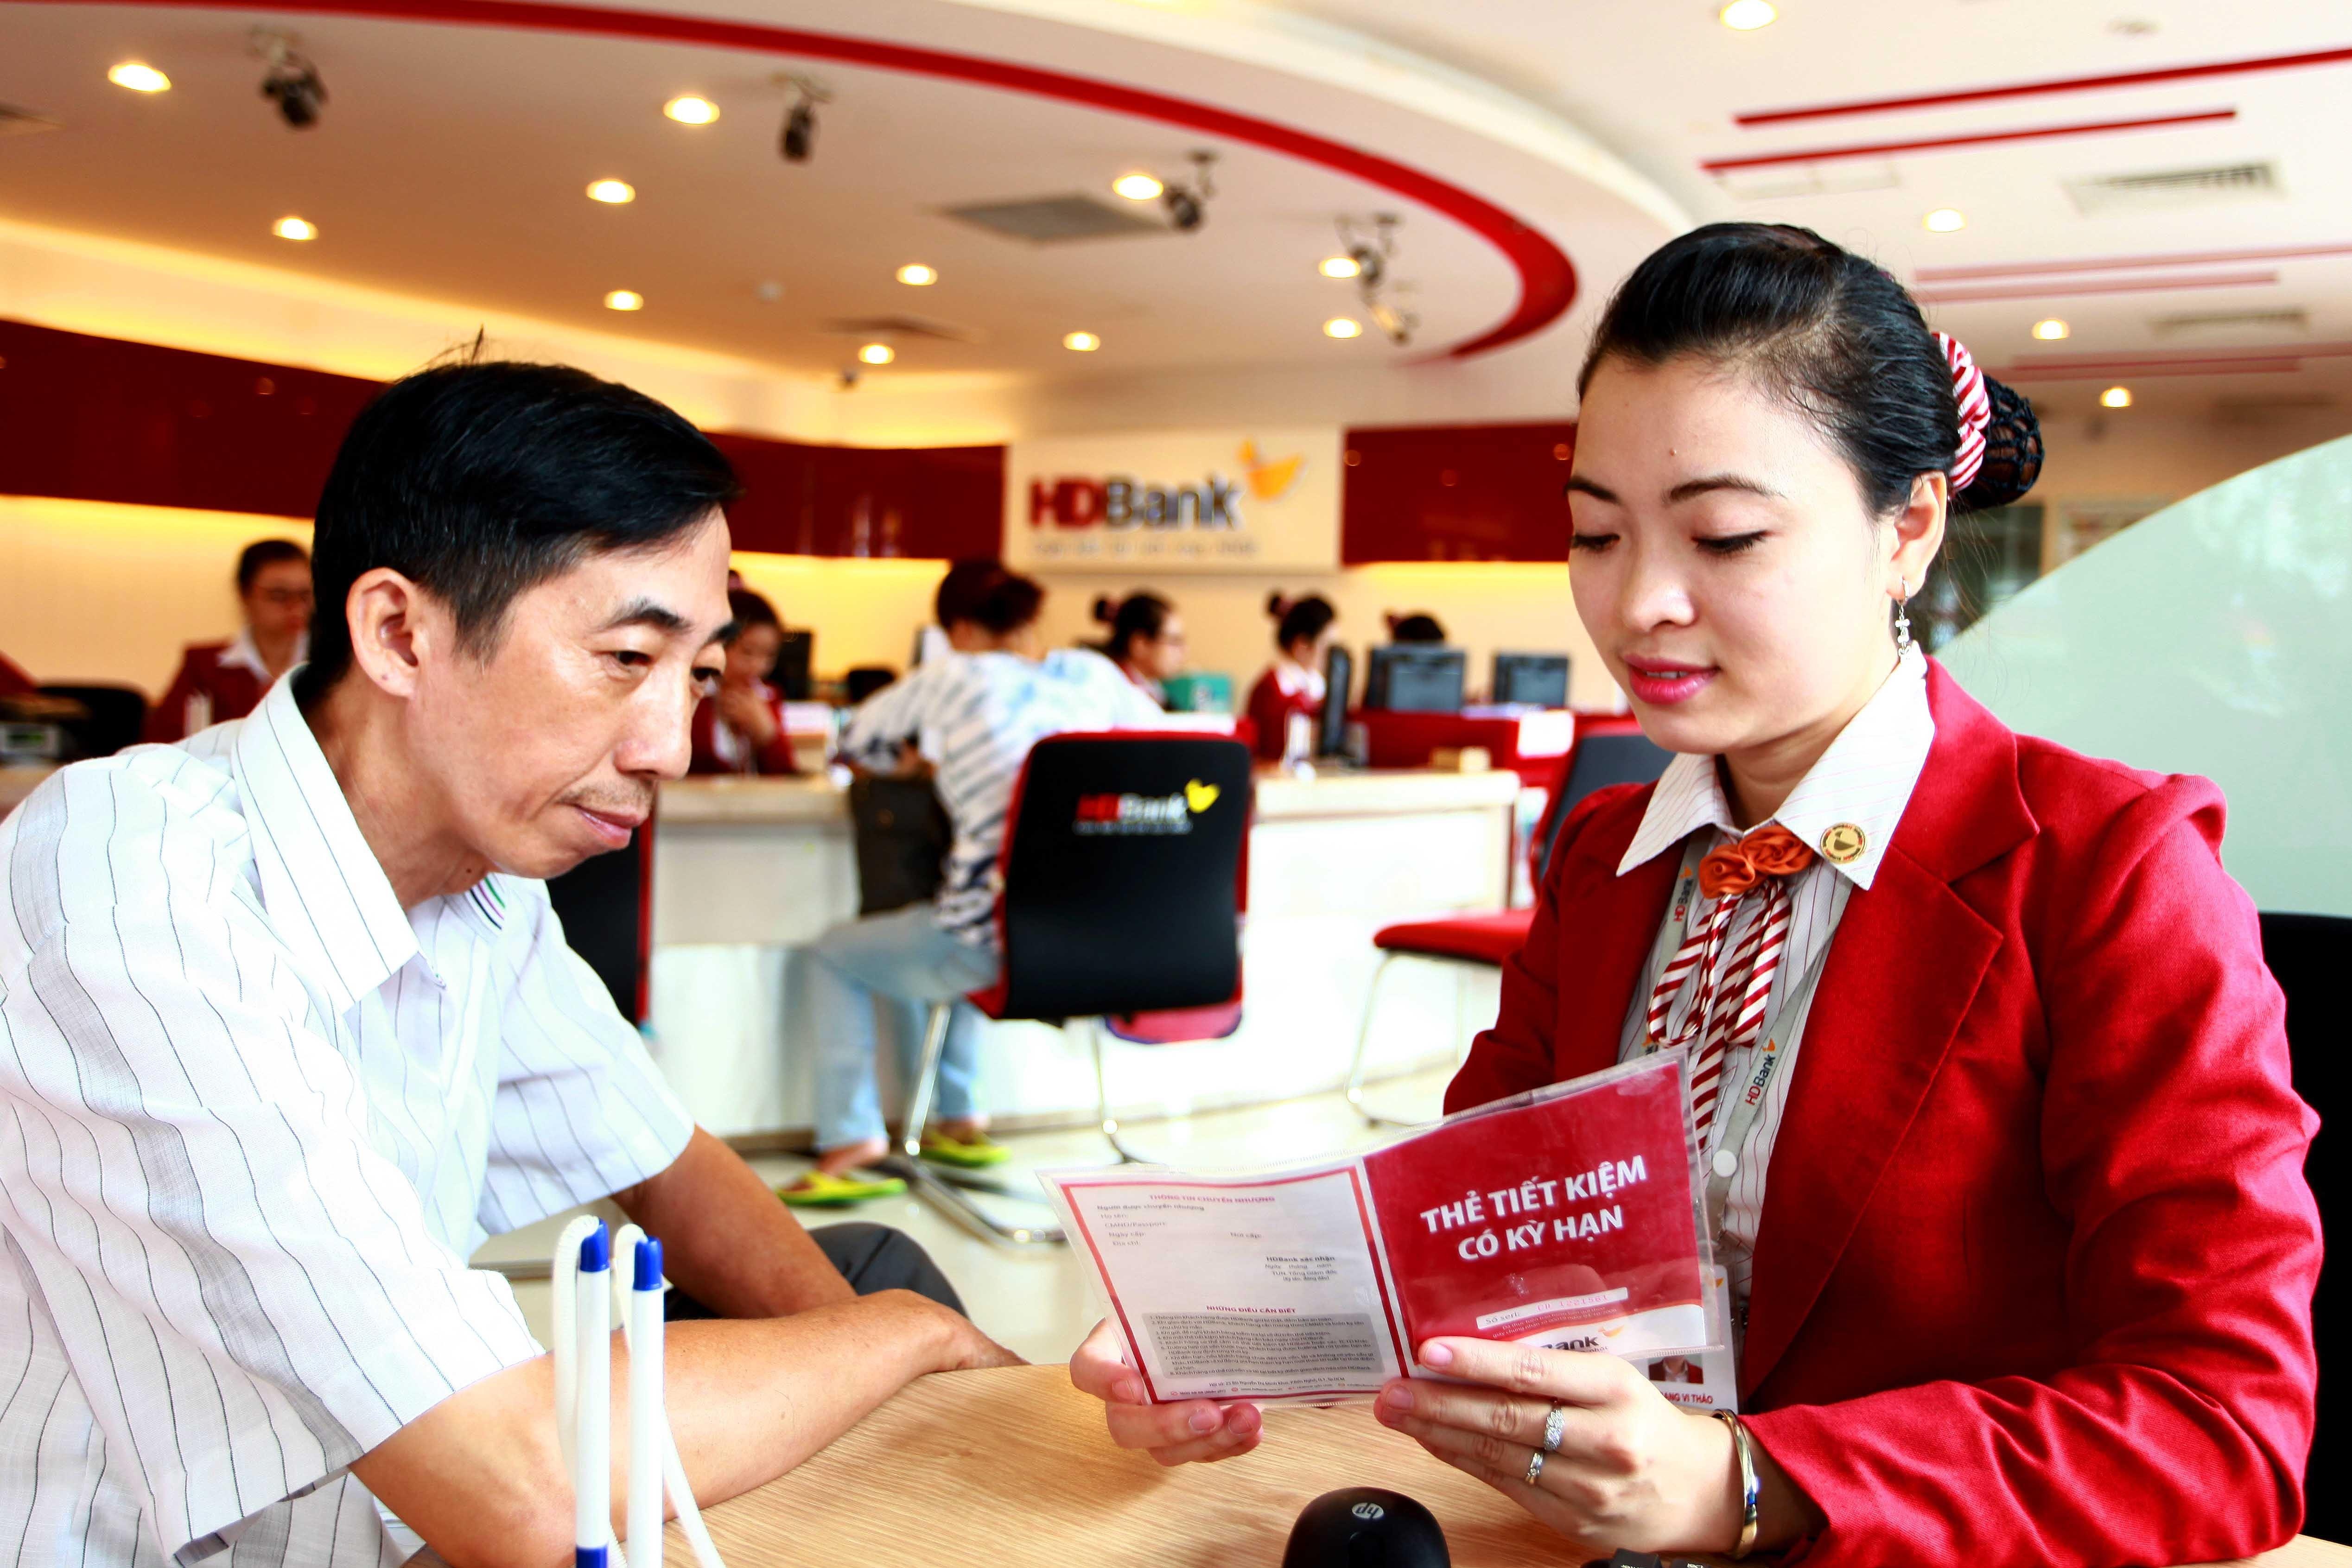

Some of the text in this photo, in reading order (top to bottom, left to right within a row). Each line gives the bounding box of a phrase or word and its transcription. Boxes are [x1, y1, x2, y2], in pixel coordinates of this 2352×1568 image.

[1029, 474, 1243, 530] HDBank
[1673, 878, 1694, 921] HDBank
[1745, 1054, 1776, 1105] HDBank
[1420, 1155, 1647, 1233] THẺ TIẾT KIỆM
[1458, 1205, 1624, 1260] CÓ KỲ HẠN
[1661, 1391, 1680, 1402] ANG
